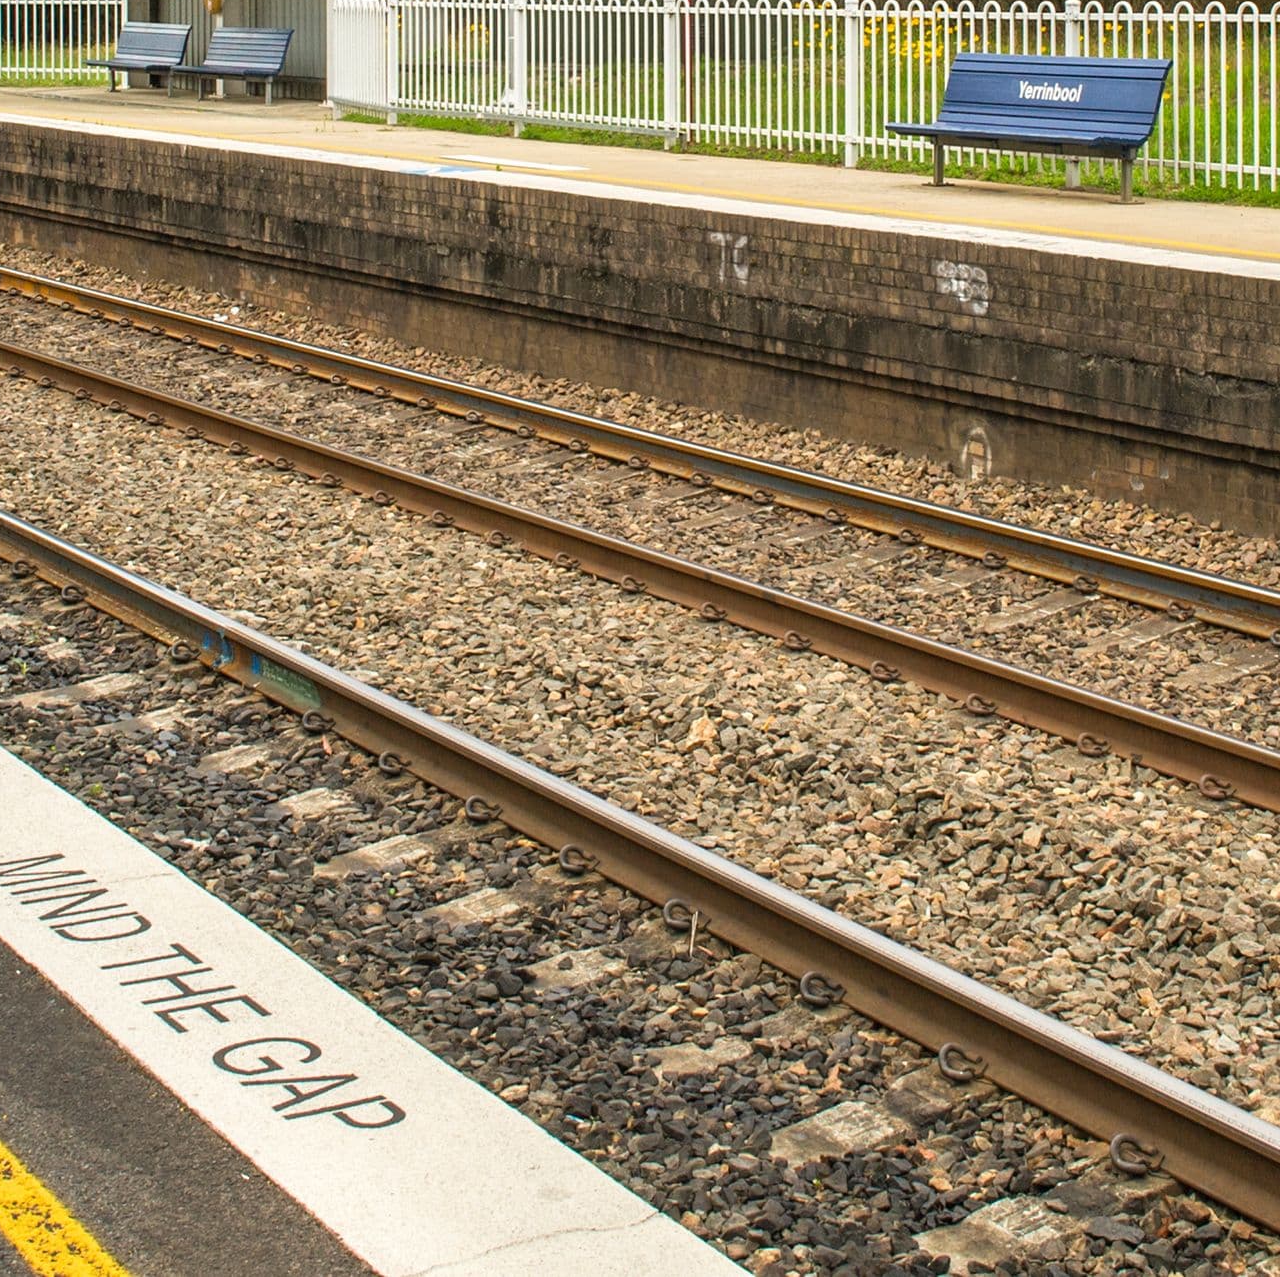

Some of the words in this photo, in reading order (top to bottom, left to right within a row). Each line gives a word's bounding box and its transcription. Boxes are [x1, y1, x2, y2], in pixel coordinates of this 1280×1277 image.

[1019, 80, 1083, 103] Yerrinbool
[100, 942, 272, 1035] THE
[212, 1036, 407, 1130] GAP
